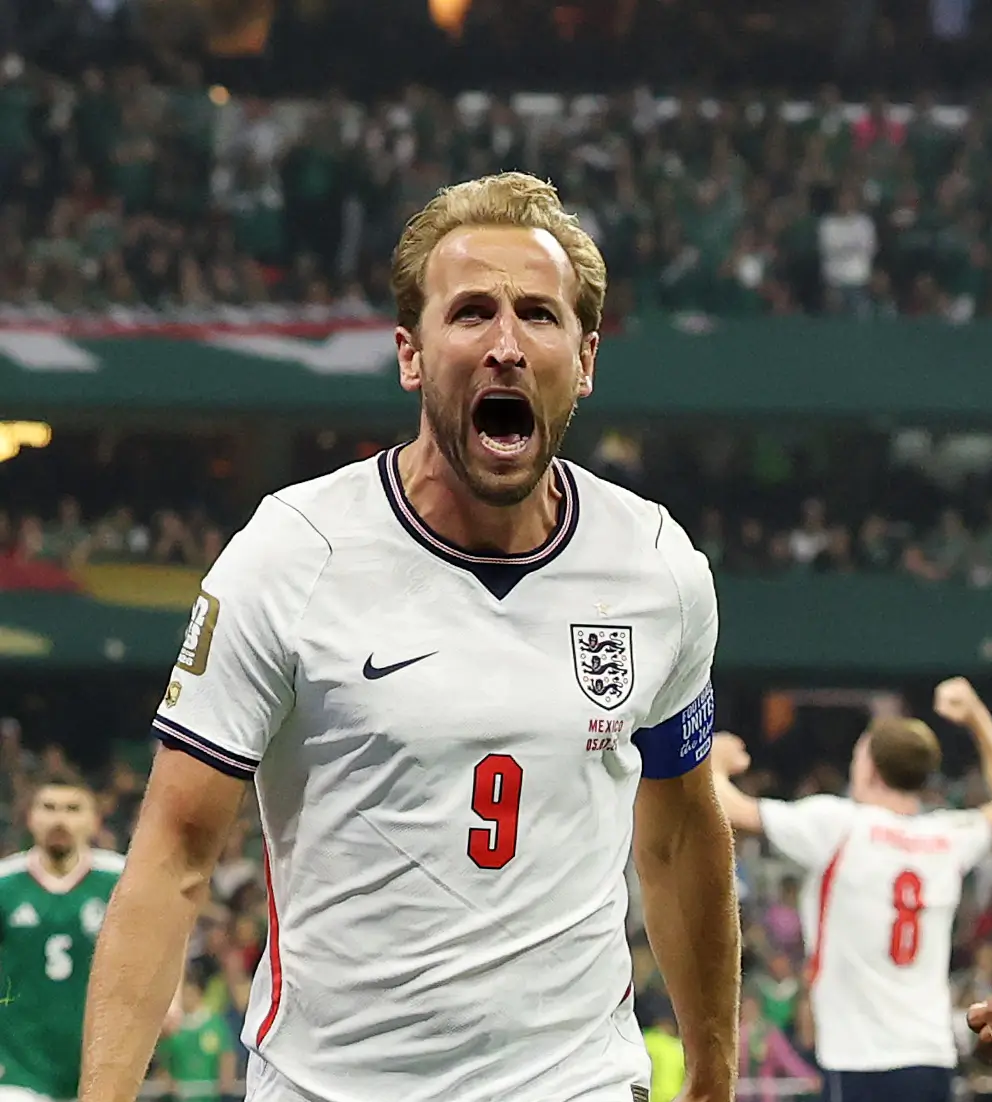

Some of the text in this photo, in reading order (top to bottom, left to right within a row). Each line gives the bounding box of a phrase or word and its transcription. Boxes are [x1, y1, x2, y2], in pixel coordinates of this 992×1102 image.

[588, 719, 624, 733] MEXICO
[467, 753, 523, 869] 9
[890, 870, 922, 968] 8
[44, 934, 73, 981] 5
